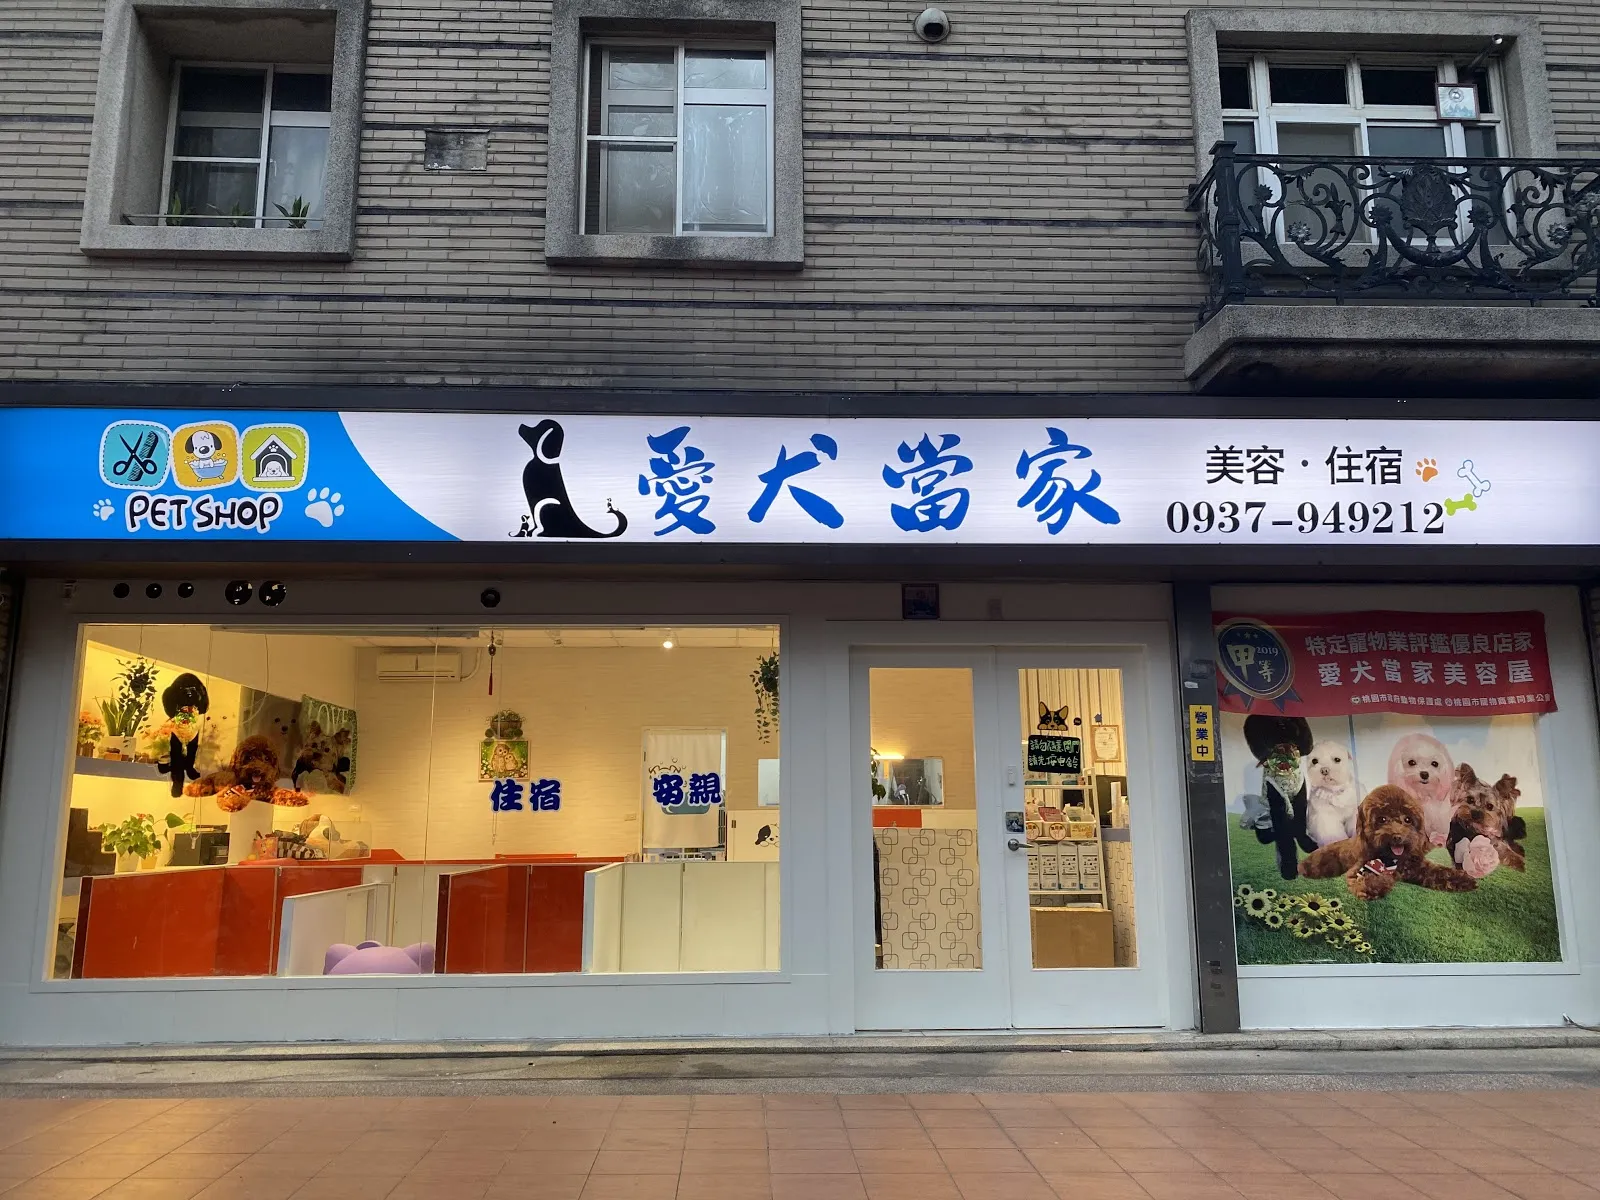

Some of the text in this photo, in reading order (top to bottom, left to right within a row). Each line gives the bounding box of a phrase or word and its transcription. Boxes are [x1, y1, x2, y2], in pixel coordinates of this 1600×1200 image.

[638, 425, 1121, 536] 愛犬當家
[129, 494, 280, 530] PET SHOP
[1166, 500, 1445, 534] 0937-949212
[1256, 646, 1280, 657] 2019
[1304, 630, 1535, 657] 特定寵物業評鑑優良店家
[1317, 658, 1535, 688] 愛犬當家美容屋
[1194, 711, 1209, 757] 營業中
[490, 778, 562, 812] 住宿
[653, 772, 722, 806] 安親
